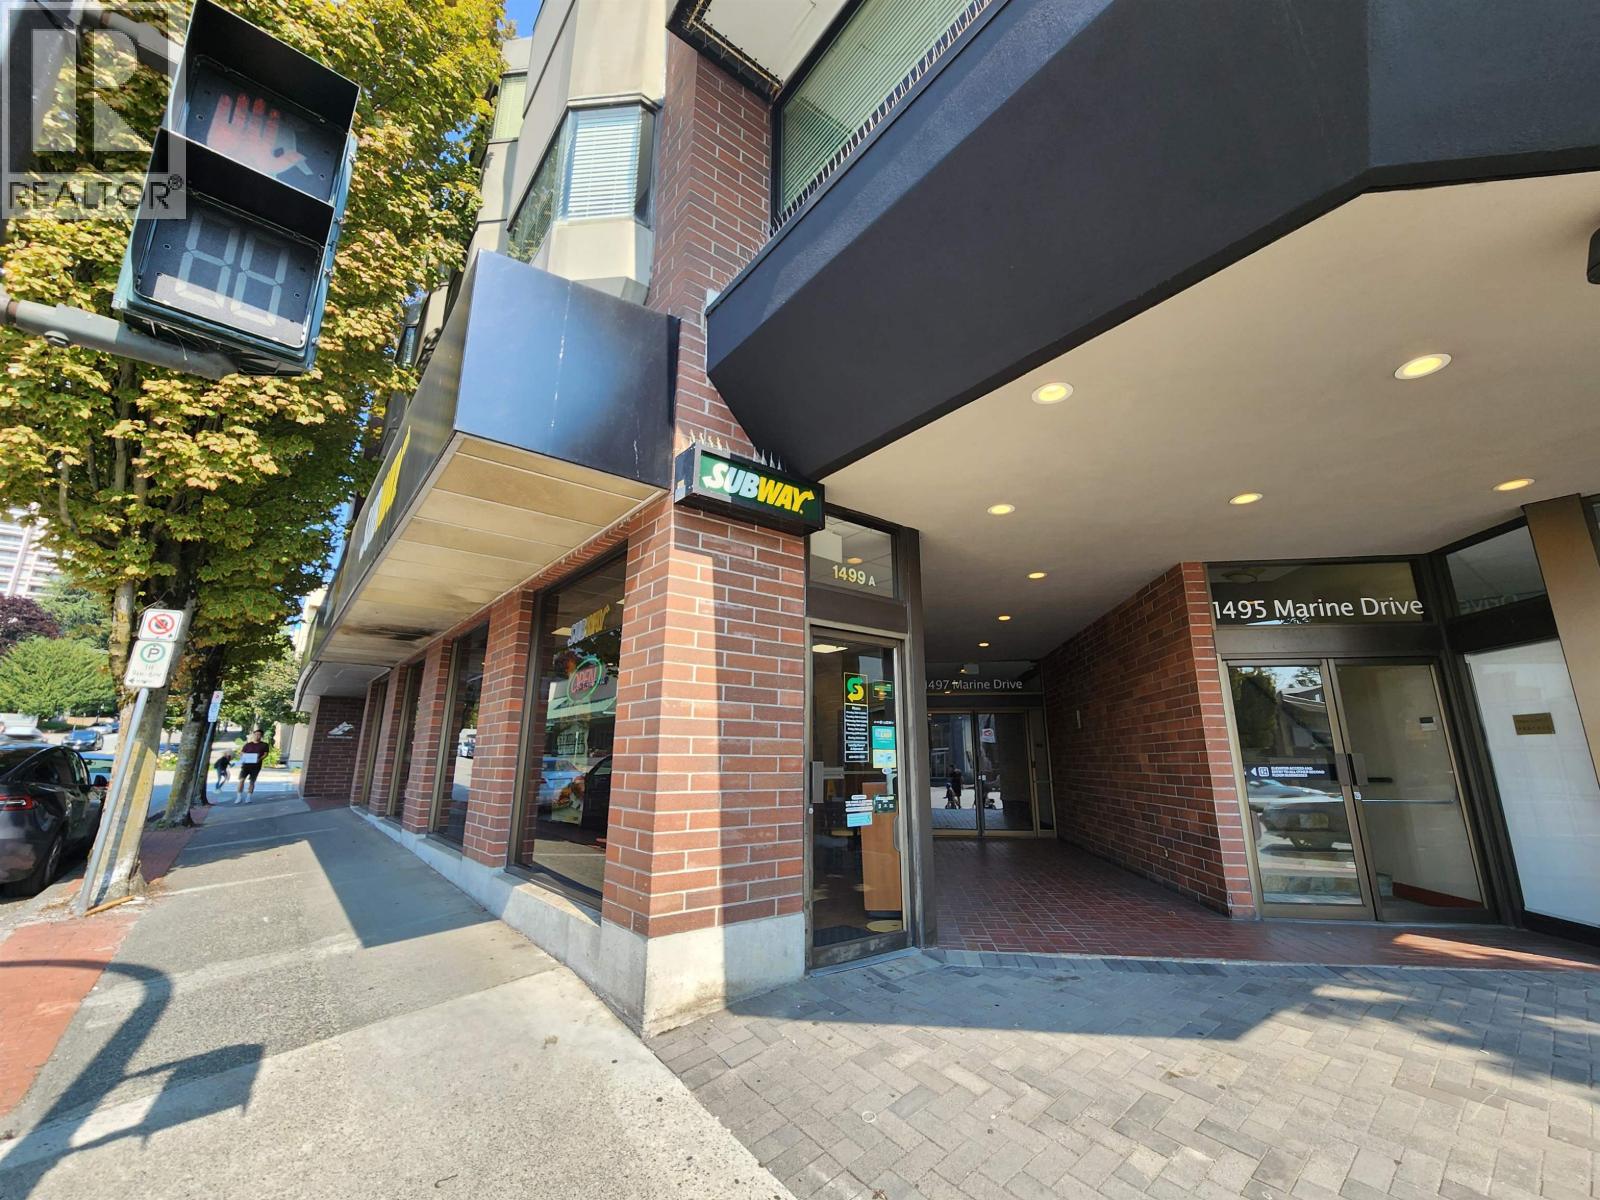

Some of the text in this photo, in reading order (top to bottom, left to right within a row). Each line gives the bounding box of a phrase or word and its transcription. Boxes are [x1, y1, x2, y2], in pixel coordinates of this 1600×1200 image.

[702, 462, 815, 514] SUBWAY
[832, 564, 876, 587] 1499 A
[1211, 597, 1425, 620] 1495 Marine Drive
[952, 679, 991, 690] Marine
[993, 678, 1023, 690] Drive
